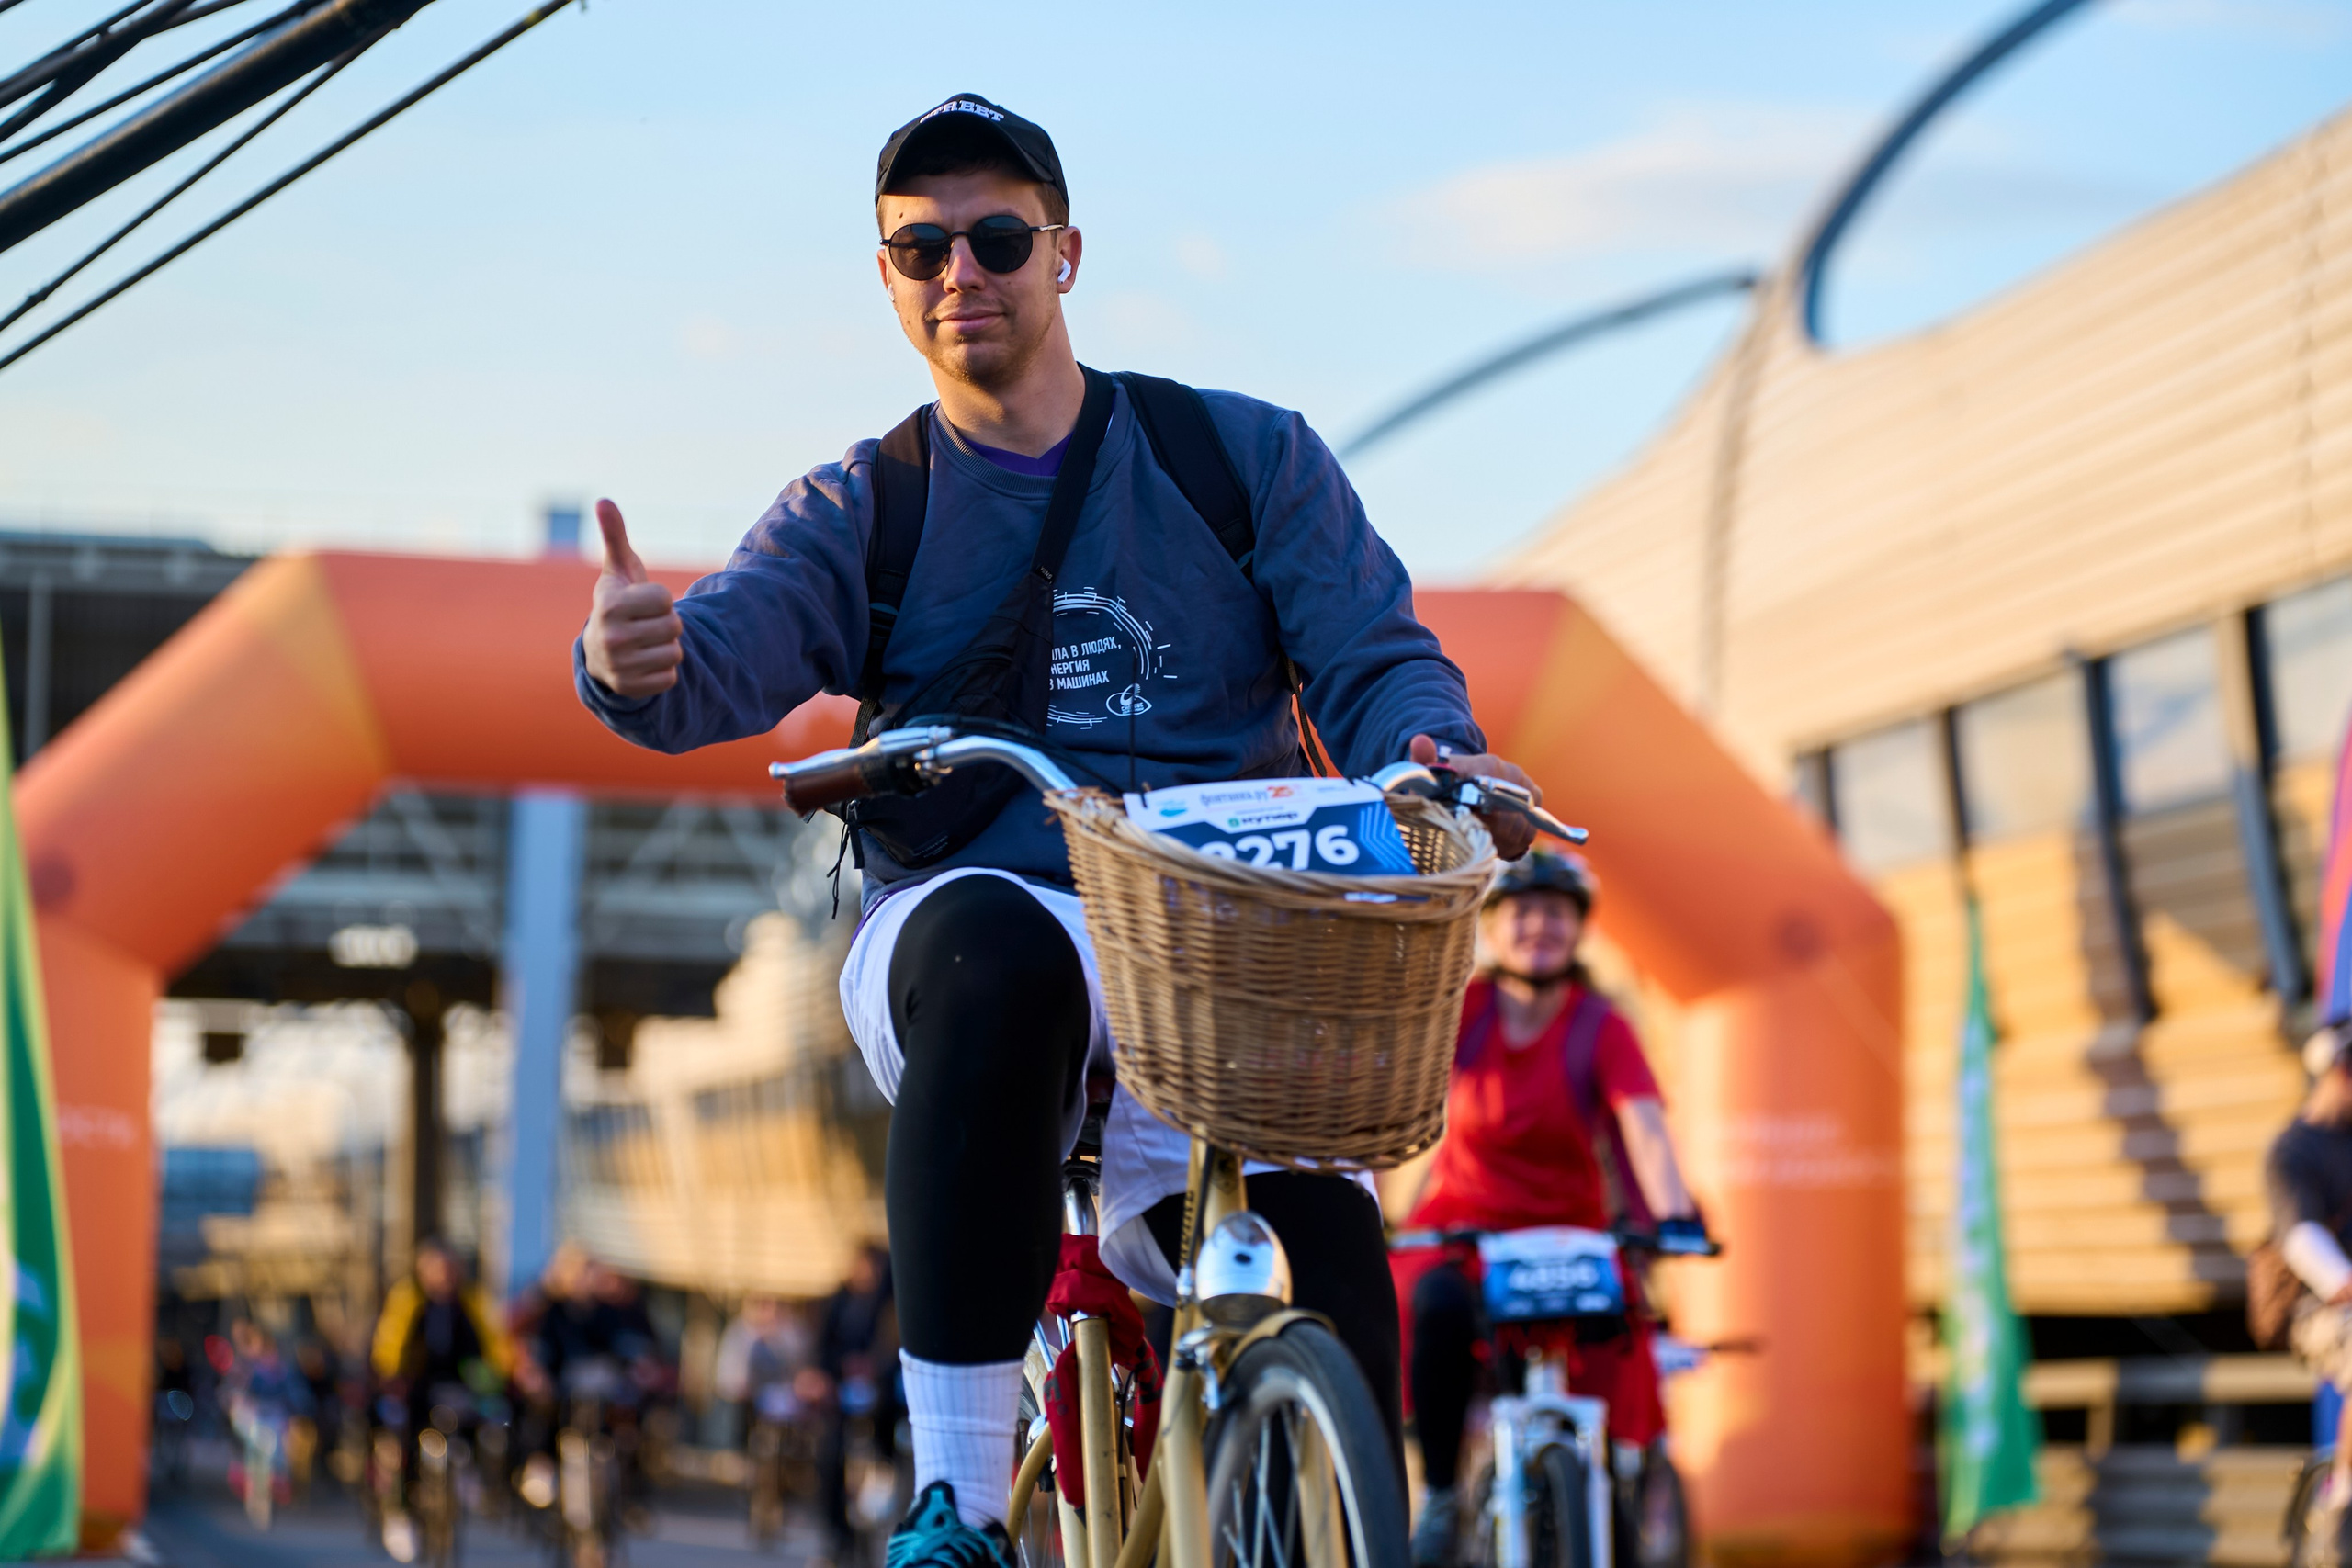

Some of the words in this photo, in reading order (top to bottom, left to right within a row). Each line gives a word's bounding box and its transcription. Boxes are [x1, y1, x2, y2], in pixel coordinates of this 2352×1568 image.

[1051, 647, 1069, 660] ЛА
[1070, 645, 1079, 658] В
[1080, 636, 1122, 656] ЛЮДЯХ,
[1056, 670, 1110, 690] МАШИНАХ
